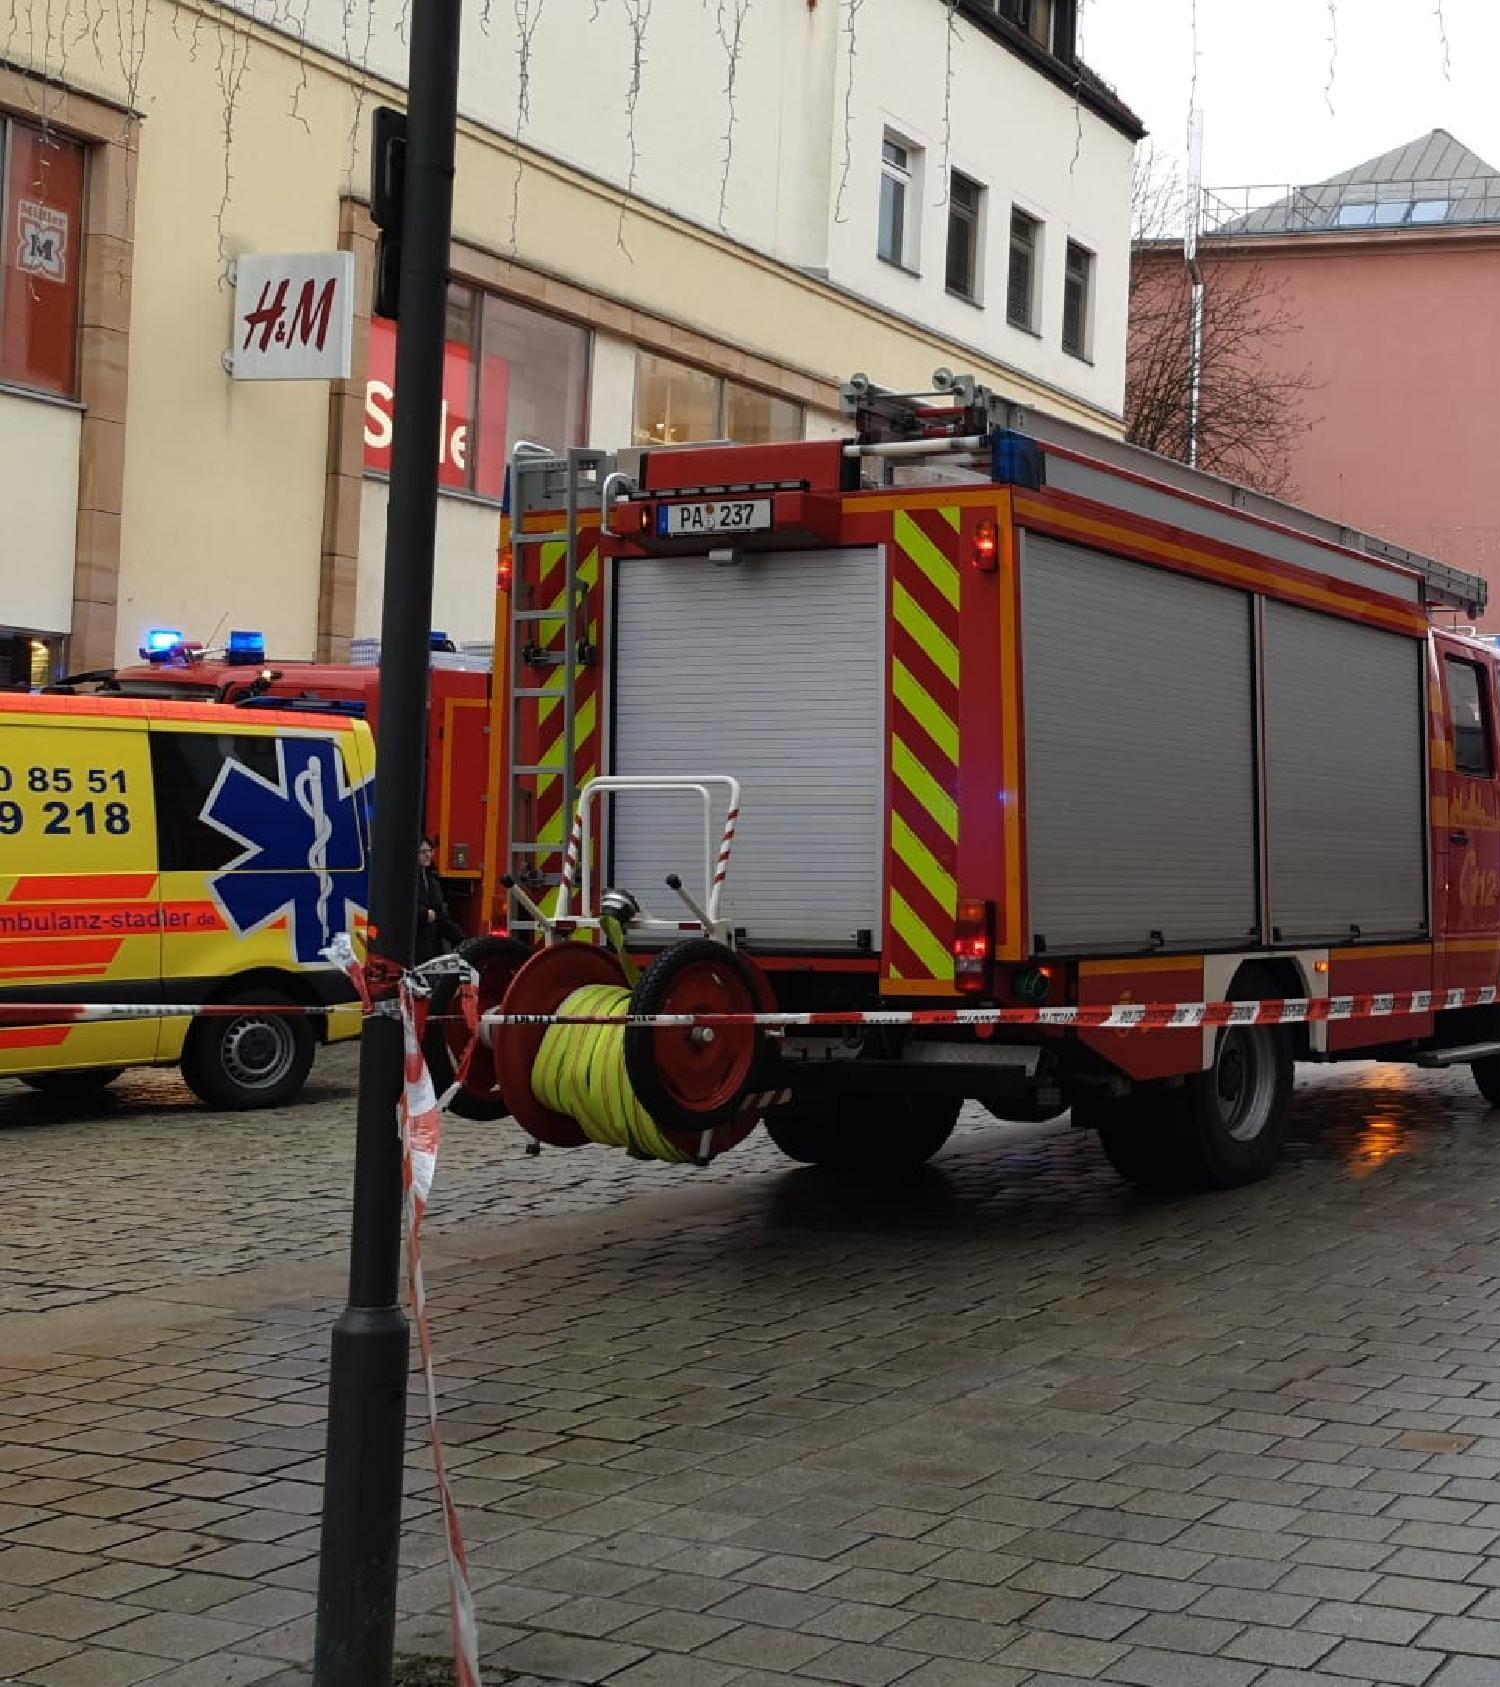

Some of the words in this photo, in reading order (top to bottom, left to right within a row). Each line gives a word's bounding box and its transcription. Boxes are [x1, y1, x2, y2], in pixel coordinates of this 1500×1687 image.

[30, 234, 54, 261] M
[243, 277, 337, 353] H&M
[363, 380, 467, 470] Sle
[681, 506, 704, 528] PA
[720, 503, 754, 527] 237
[28, 767, 73, 793] 85
[88, 769, 126, 794] 51
[43, 801, 131, 834] 218
